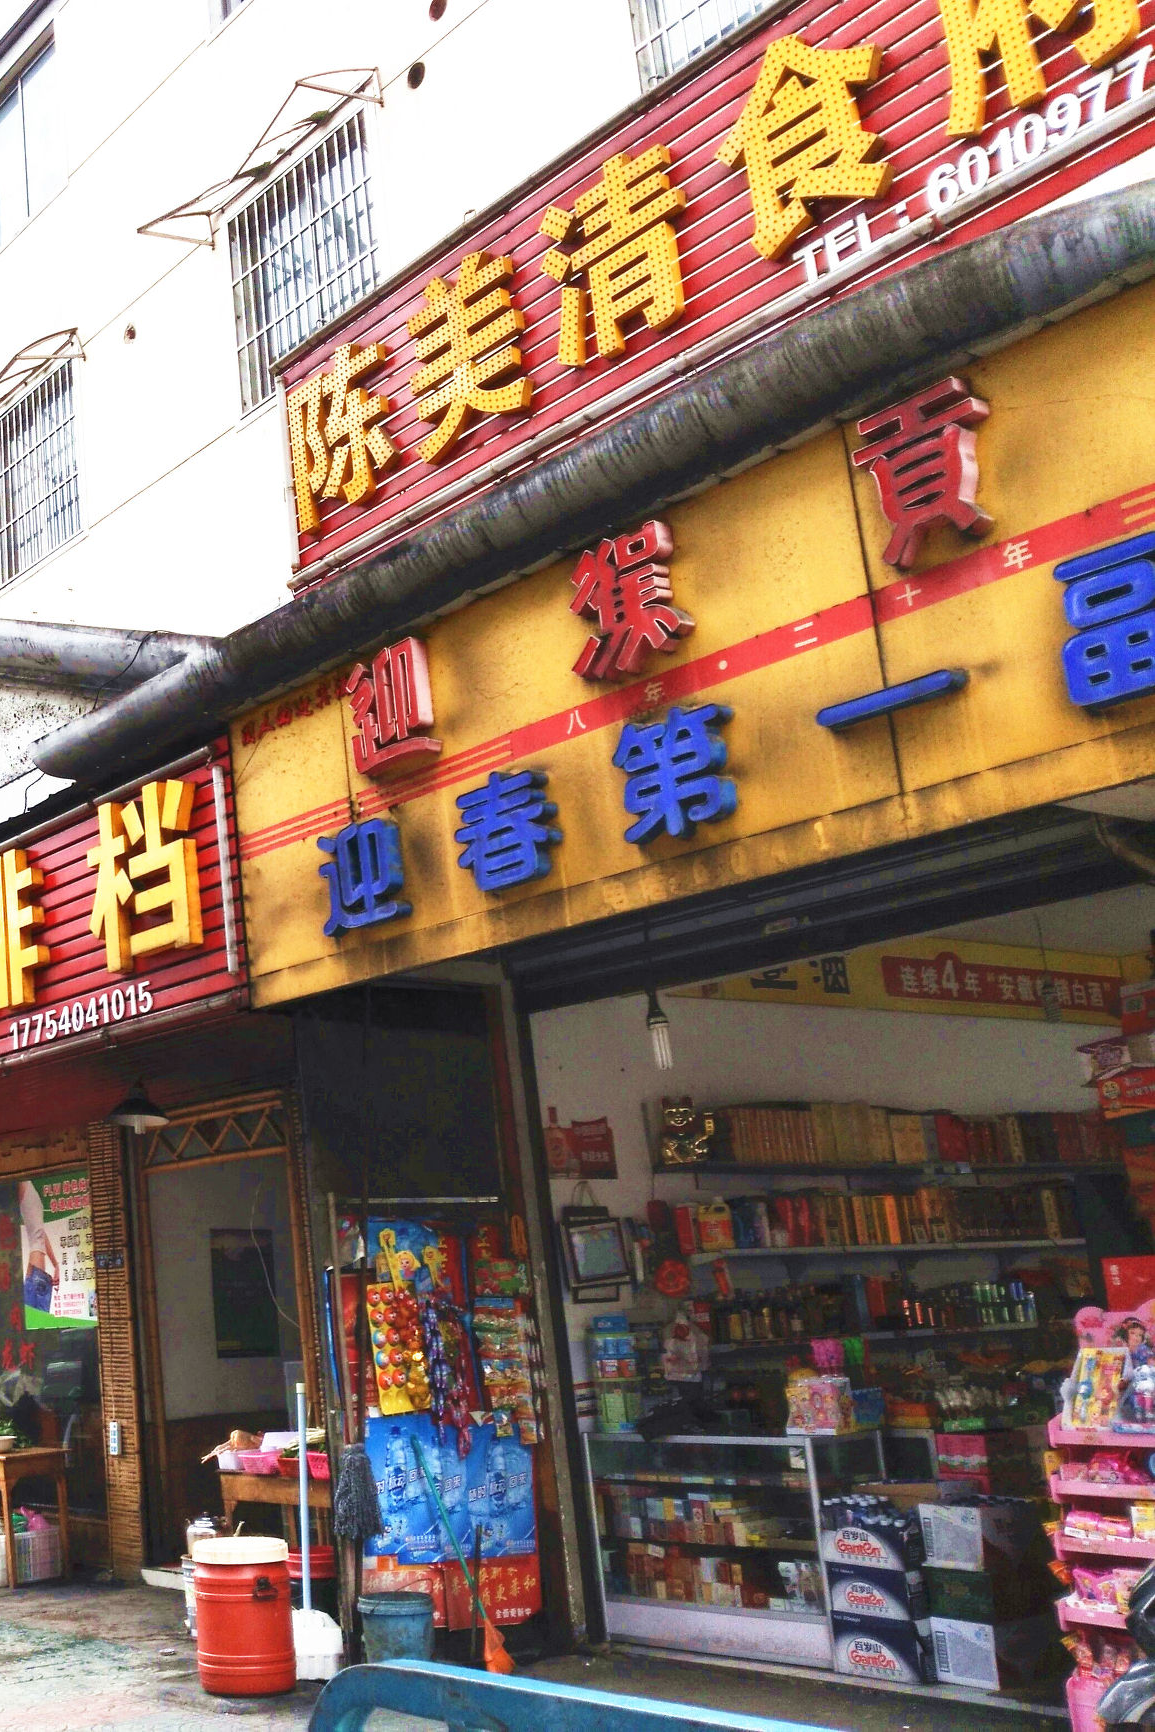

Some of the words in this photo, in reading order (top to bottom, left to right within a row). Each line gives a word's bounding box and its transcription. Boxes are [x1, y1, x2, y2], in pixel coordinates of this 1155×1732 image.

[9, 981, 154, 1051] 17754041015
[842, 1529, 869, 1543] 百岁山
[854, 1640, 882, 1654] 百岁山
